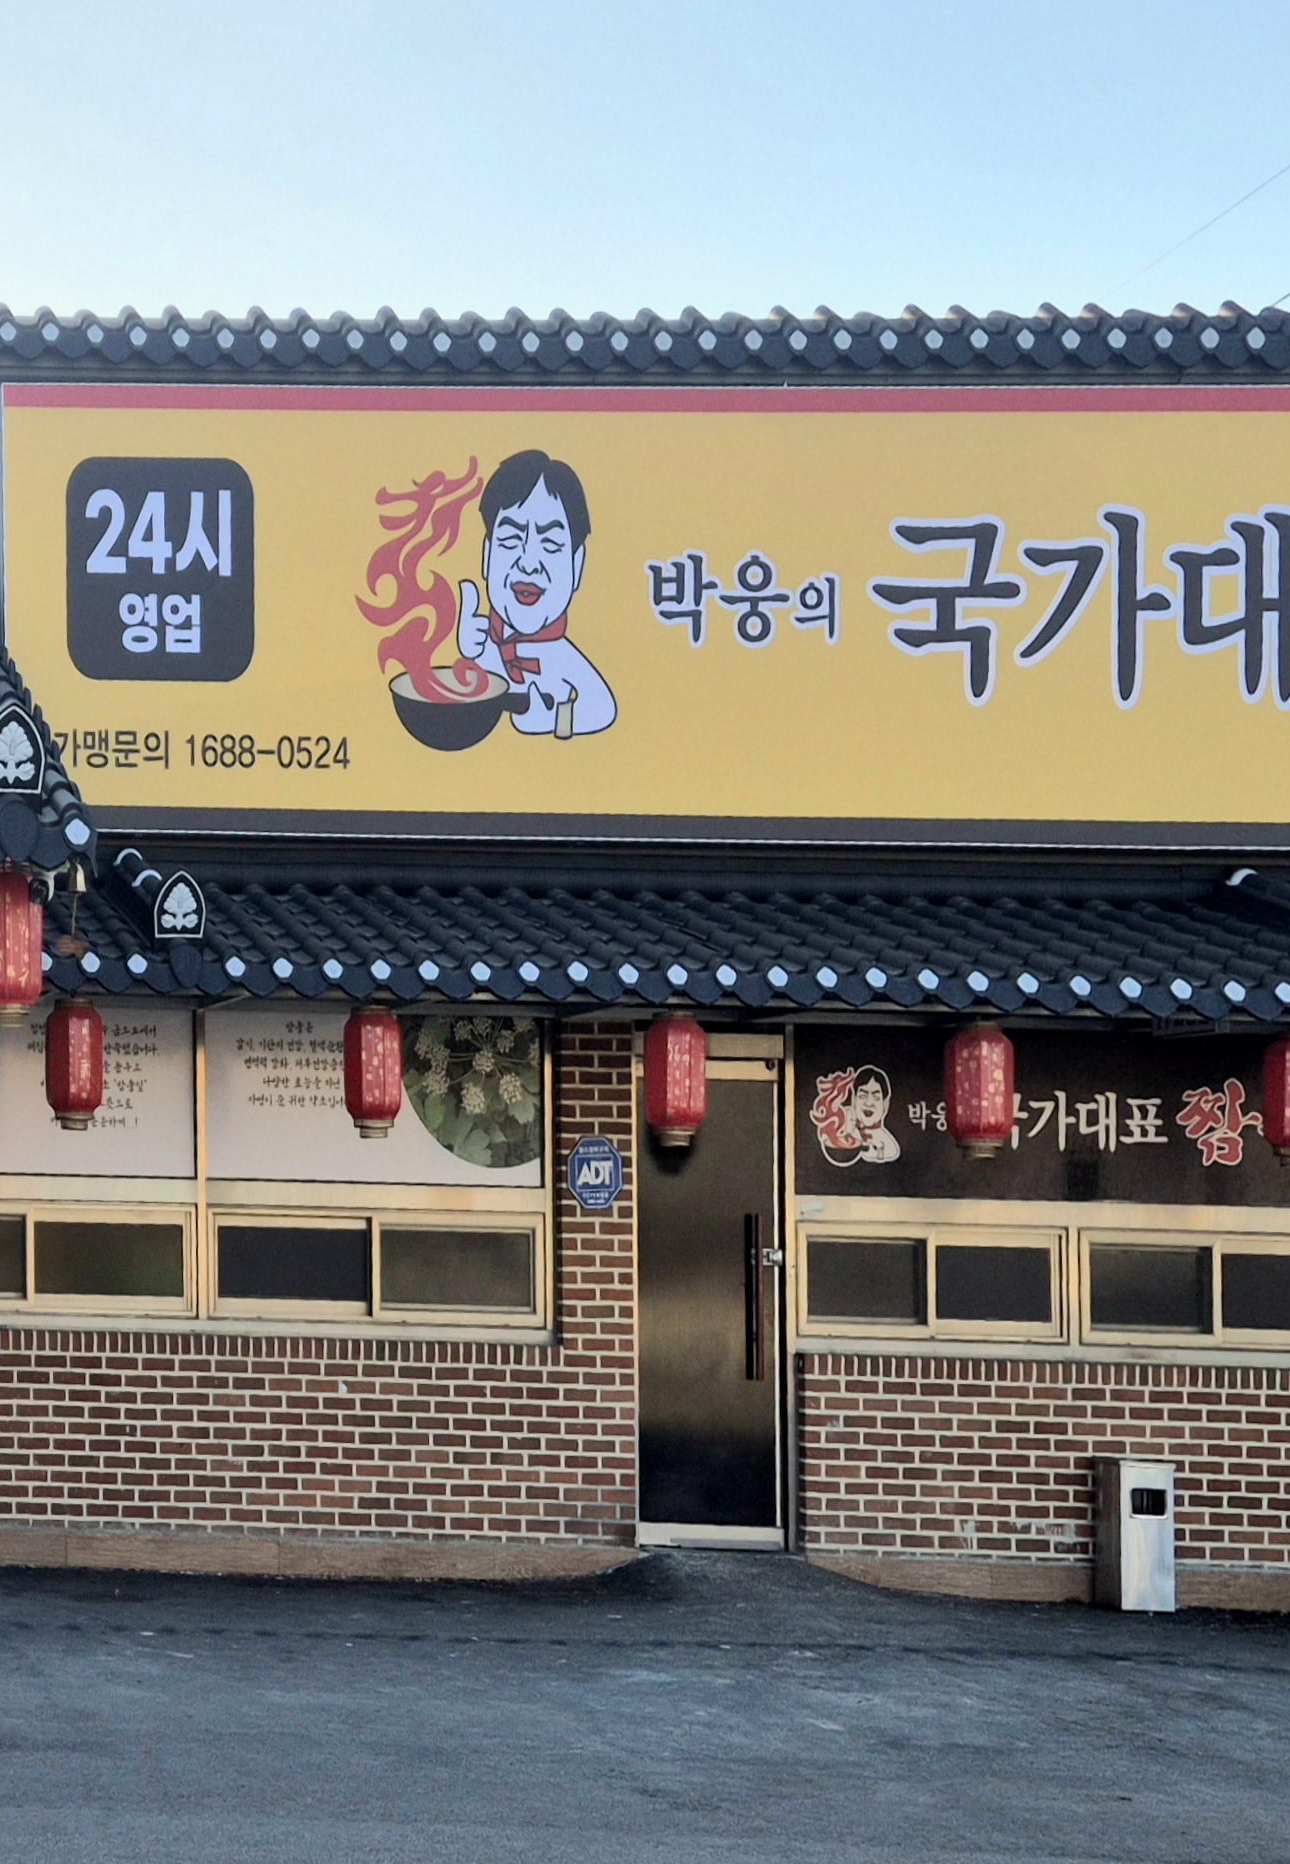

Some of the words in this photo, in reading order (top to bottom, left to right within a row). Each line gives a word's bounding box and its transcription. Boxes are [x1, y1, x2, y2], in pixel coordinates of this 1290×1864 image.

[85, 488, 232, 577] 24시
[118, 592, 203, 653] 영업
[647, 553, 839, 644] 박웅의
[54, 728, 169, 769] 가맹문의
[185, 733, 351, 770] 1688-0524
[309, 1095, 346, 1109] 약초입니
[907, 1100, 947, 1132] 박웅
[1175, 1077, 1265, 1167] 짬
[576, 1160, 614, 1186] ADT
